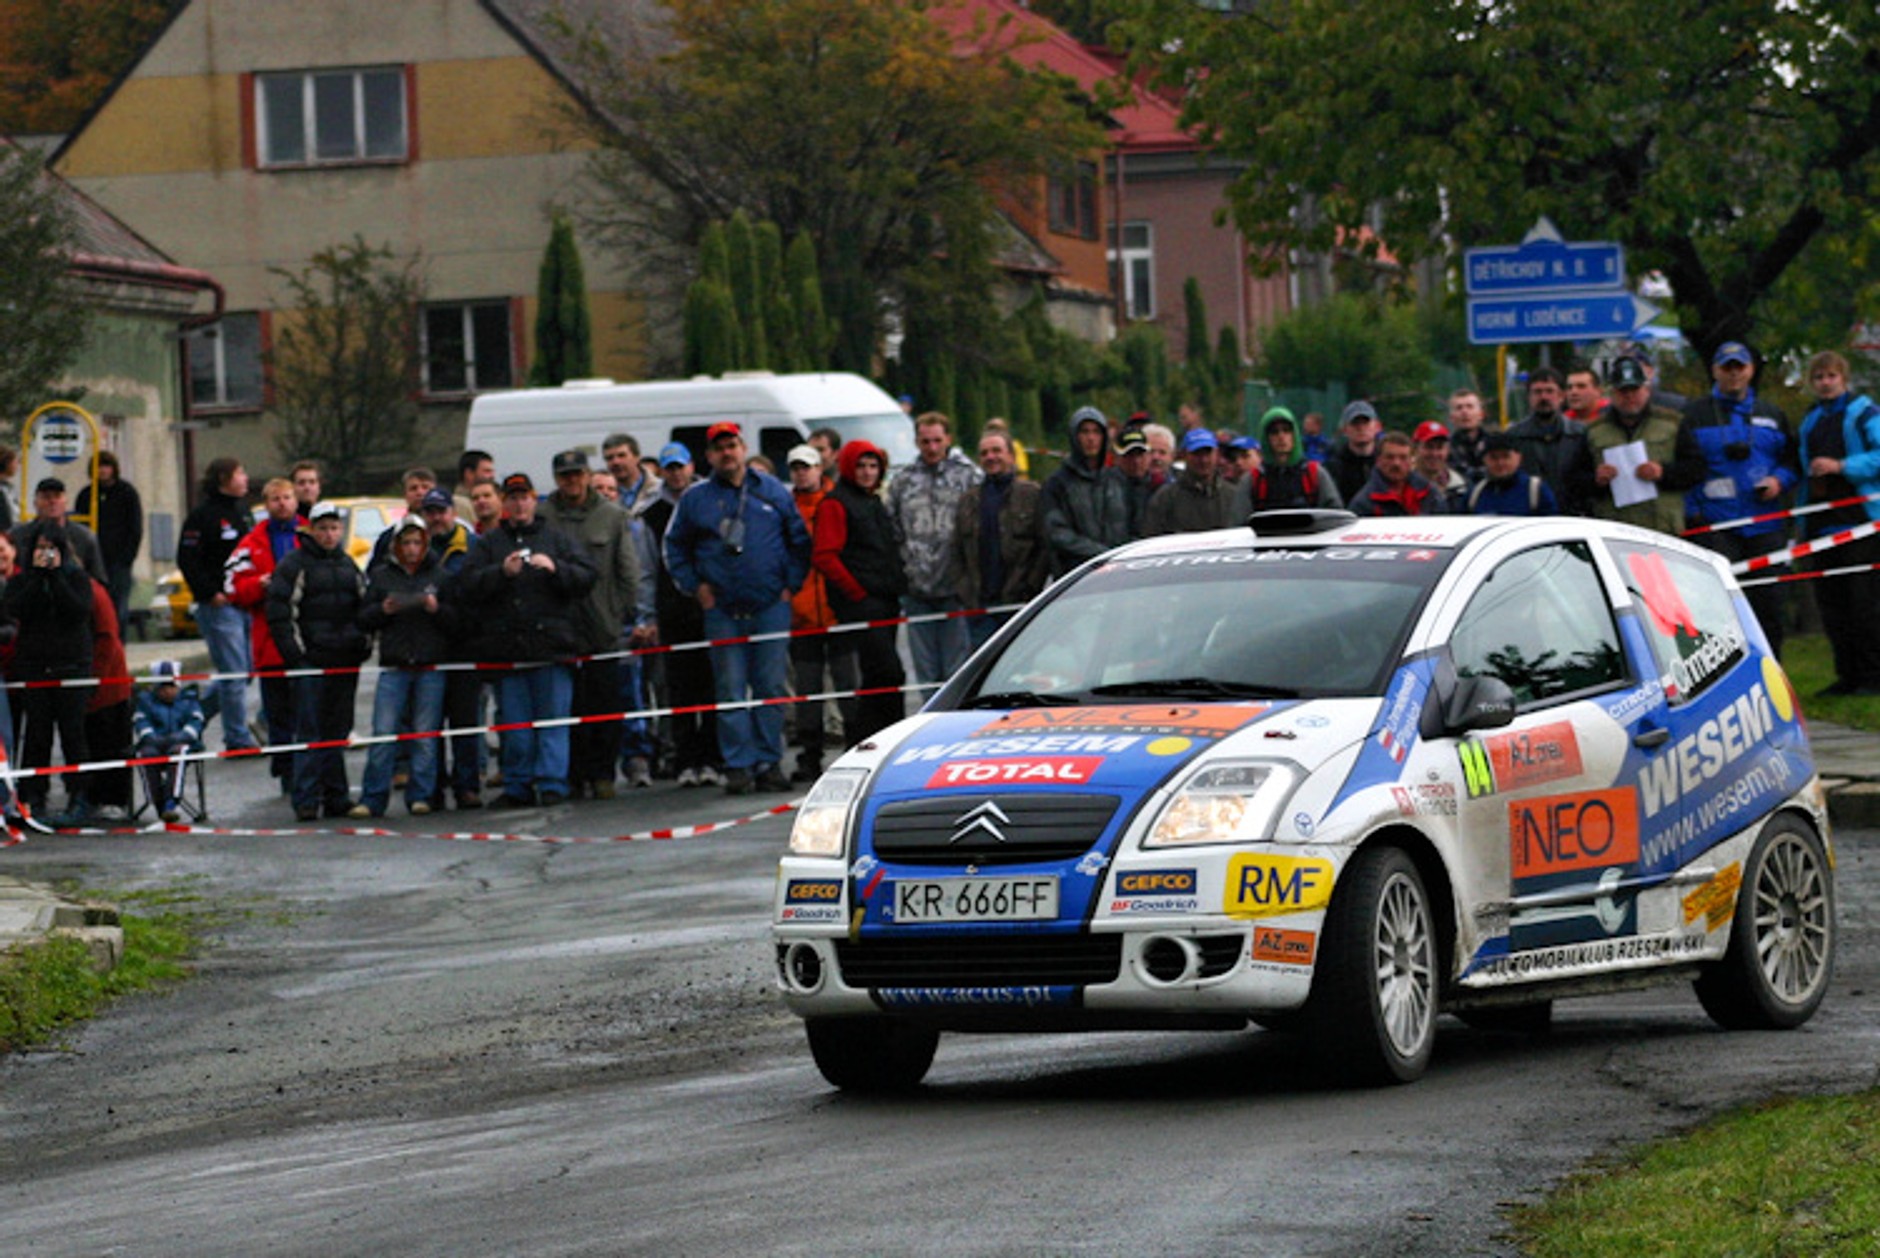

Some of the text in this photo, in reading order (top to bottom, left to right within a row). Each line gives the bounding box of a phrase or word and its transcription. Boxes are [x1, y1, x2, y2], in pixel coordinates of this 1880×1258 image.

[1611, 306, 1622, 324] 4
[892, 734, 1144, 767] WESEM
[1638, 682, 1773, 818] WESEM
[944, 761, 1087, 782] TOTAL
[1641, 748, 1792, 868] www.wesem.pl
[1523, 799, 1614, 866] NEO
[789, 884, 839, 899] GEFCO
[1121, 873, 1192, 891] GEFCO
[1237, 865, 1322, 904] RMF
[900, 882, 1051, 918] KR 666FF
